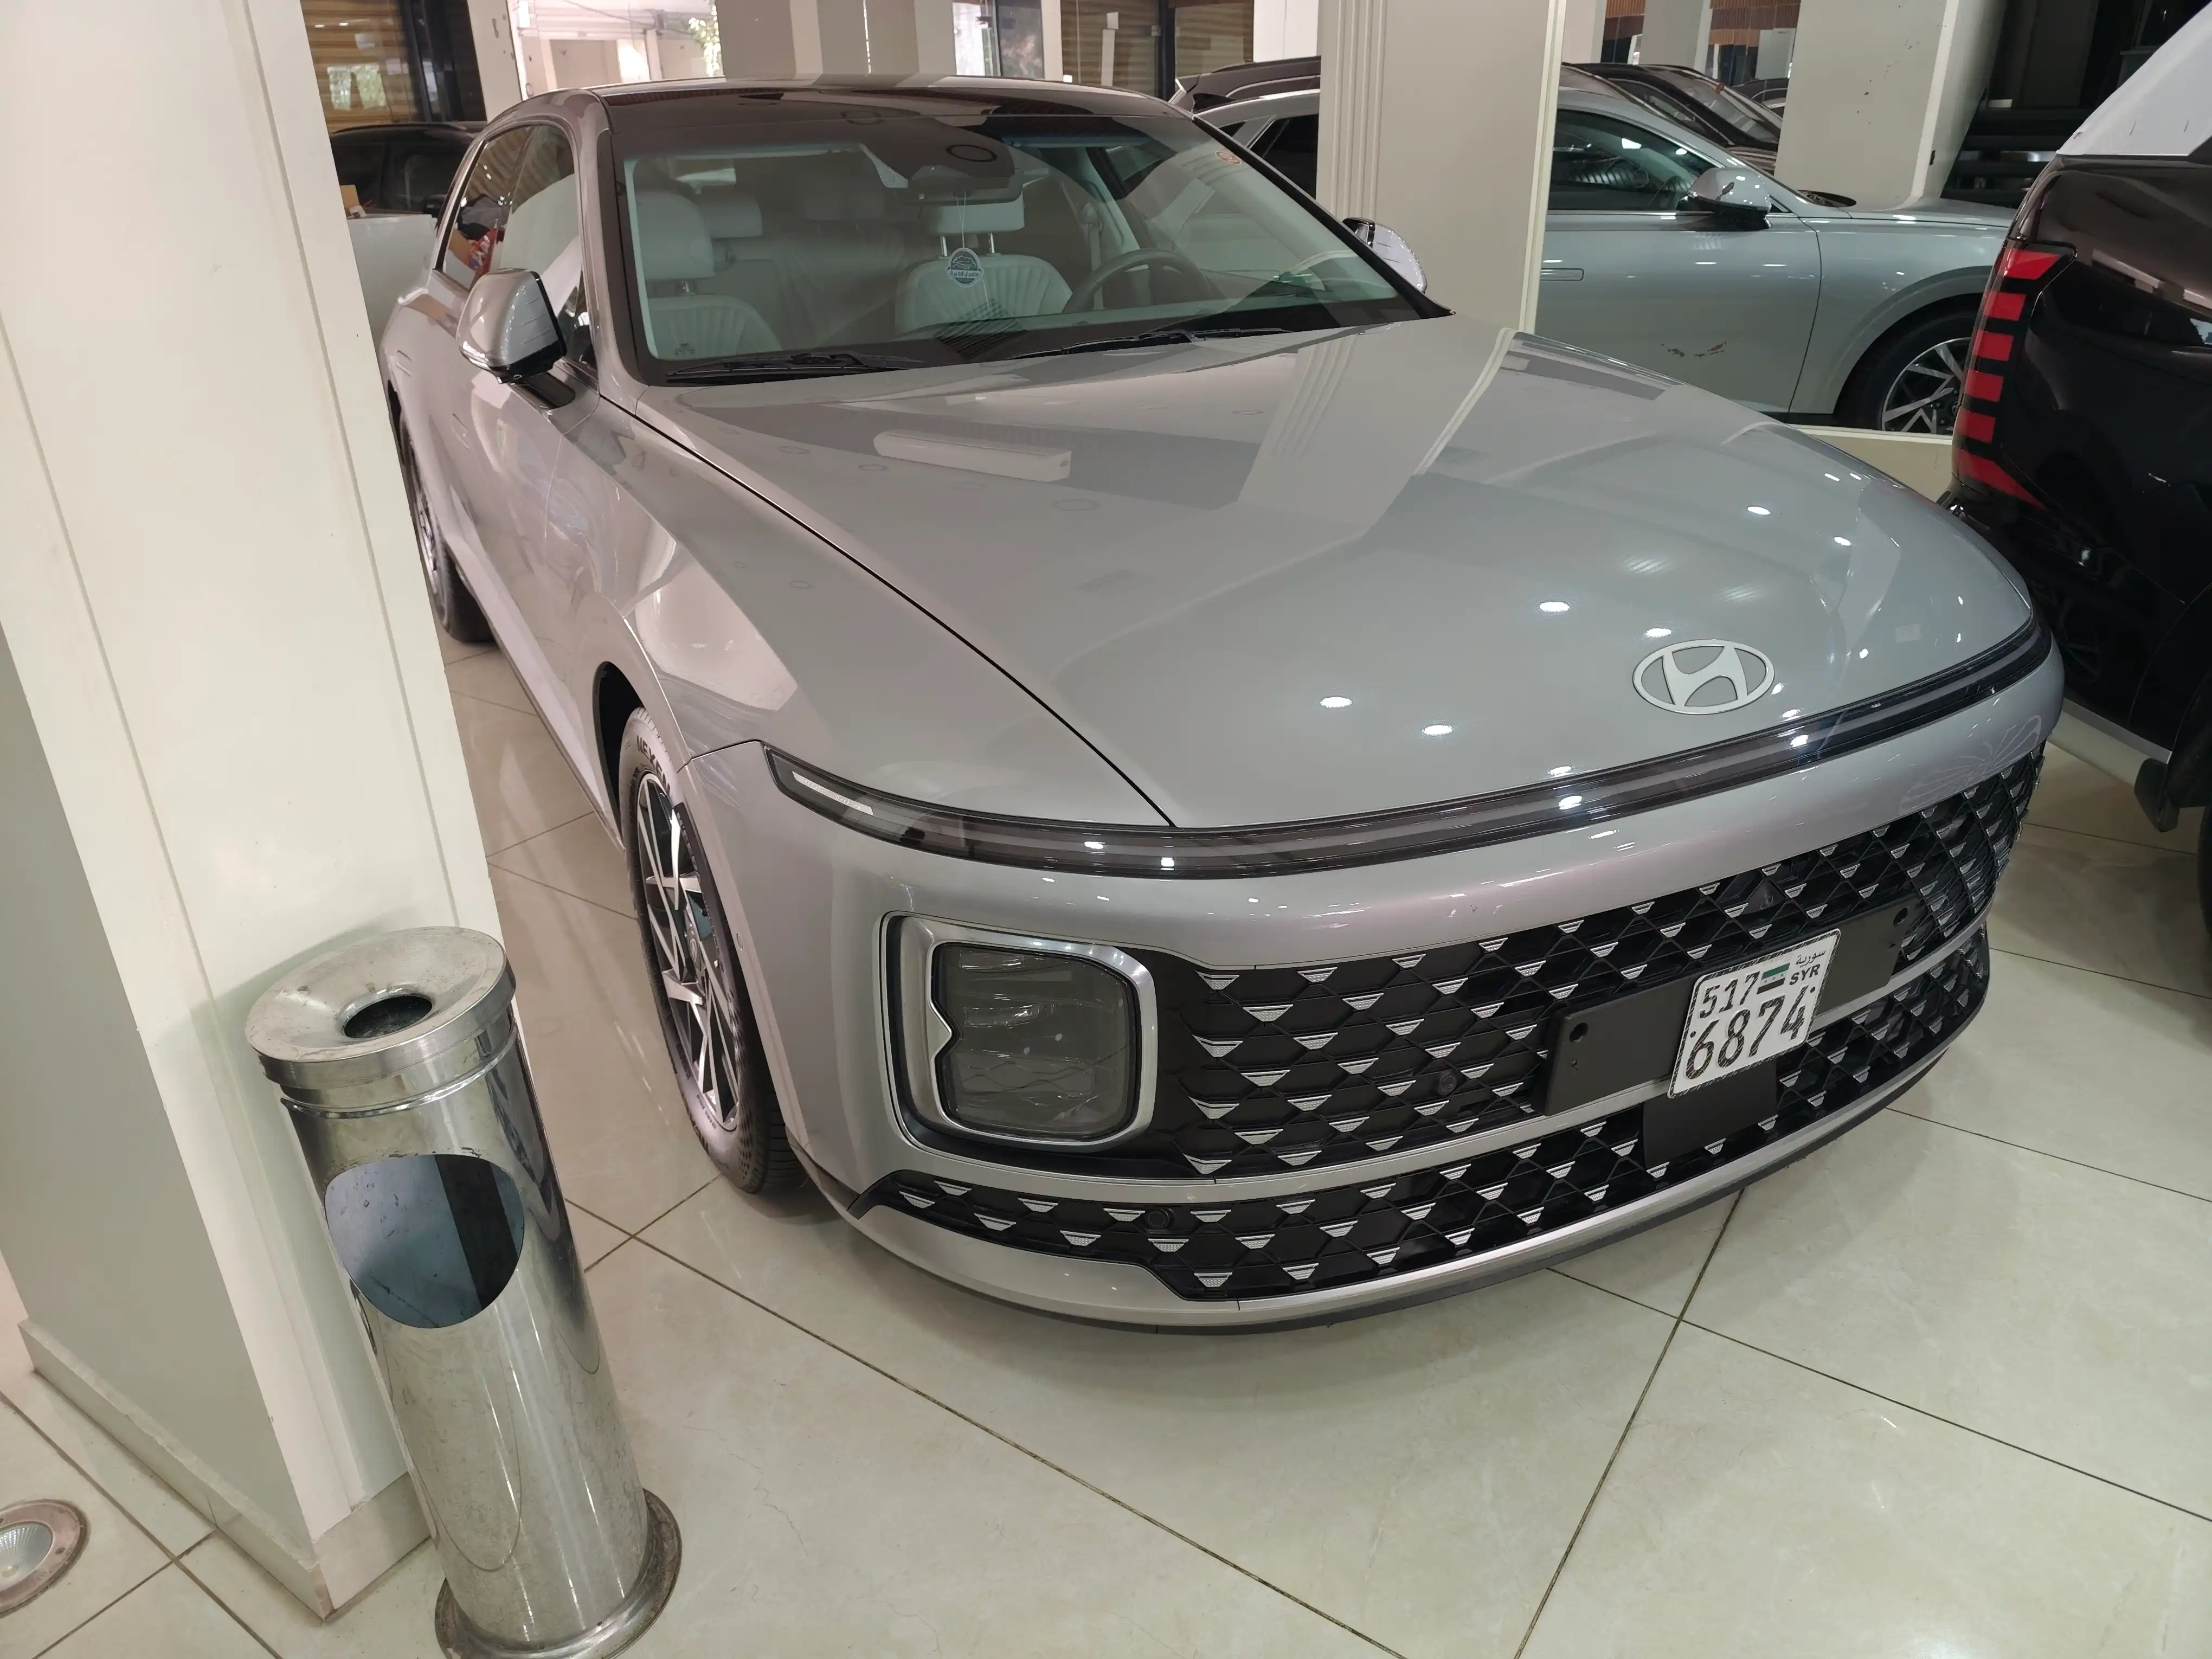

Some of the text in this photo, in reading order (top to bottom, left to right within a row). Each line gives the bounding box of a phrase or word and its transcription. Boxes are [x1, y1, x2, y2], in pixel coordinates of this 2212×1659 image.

[1789, 963, 1820, 986] SYR
[1796, 950, 1826, 968] سورية
[1699, 970, 1760, 1018] 517
[1686, 985, 1809, 1079] 6874
